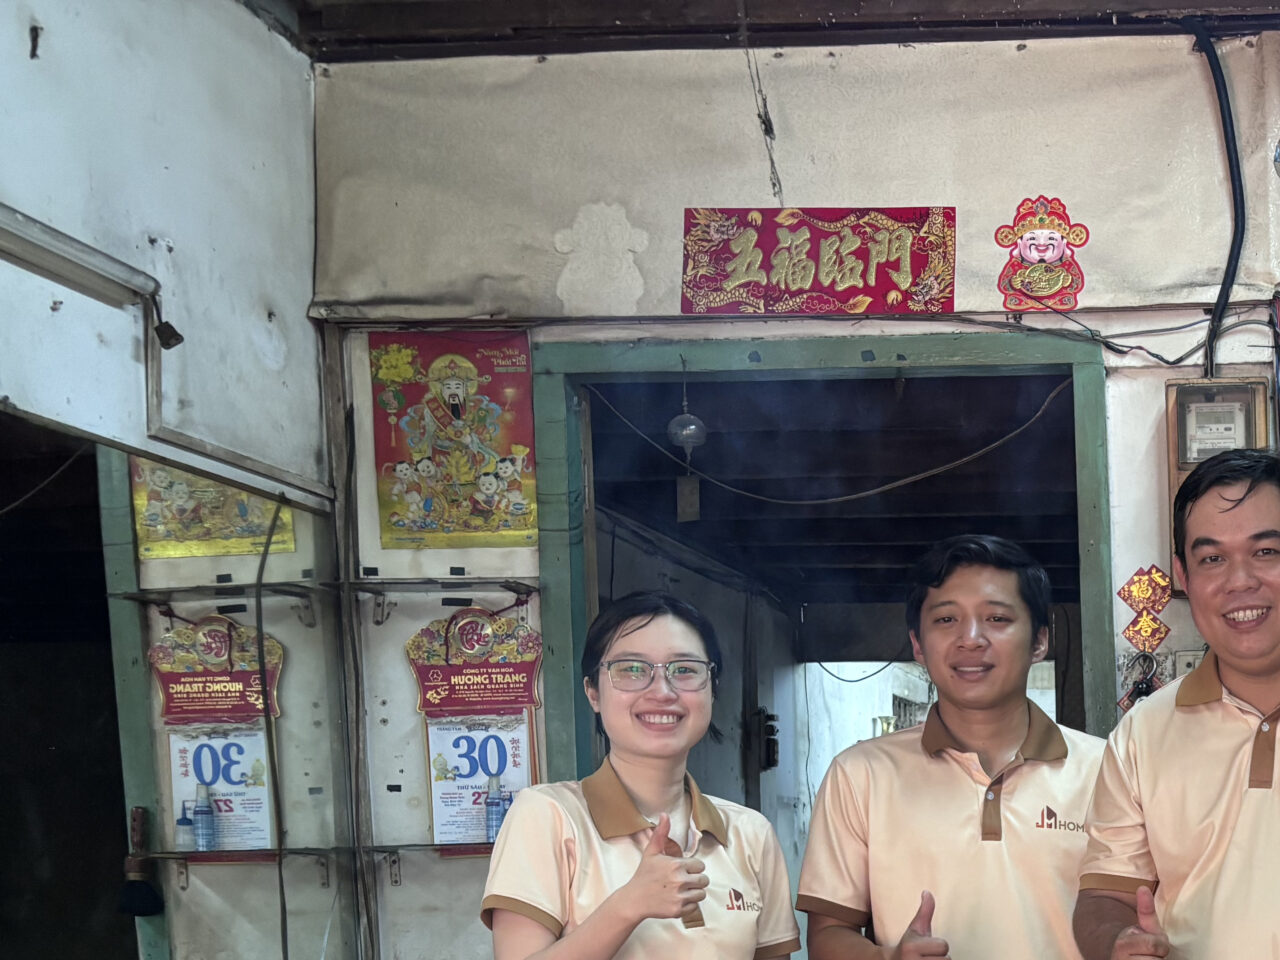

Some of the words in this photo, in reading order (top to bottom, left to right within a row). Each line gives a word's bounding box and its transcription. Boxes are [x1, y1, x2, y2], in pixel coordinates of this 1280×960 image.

[720, 226, 914, 292] 五福臨門
[491, 673, 528, 684] TRANG
[452, 734, 508, 779] 30
[472, 791, 489, 806] 27
[1035, 805, 1085, 833] JMHOM
